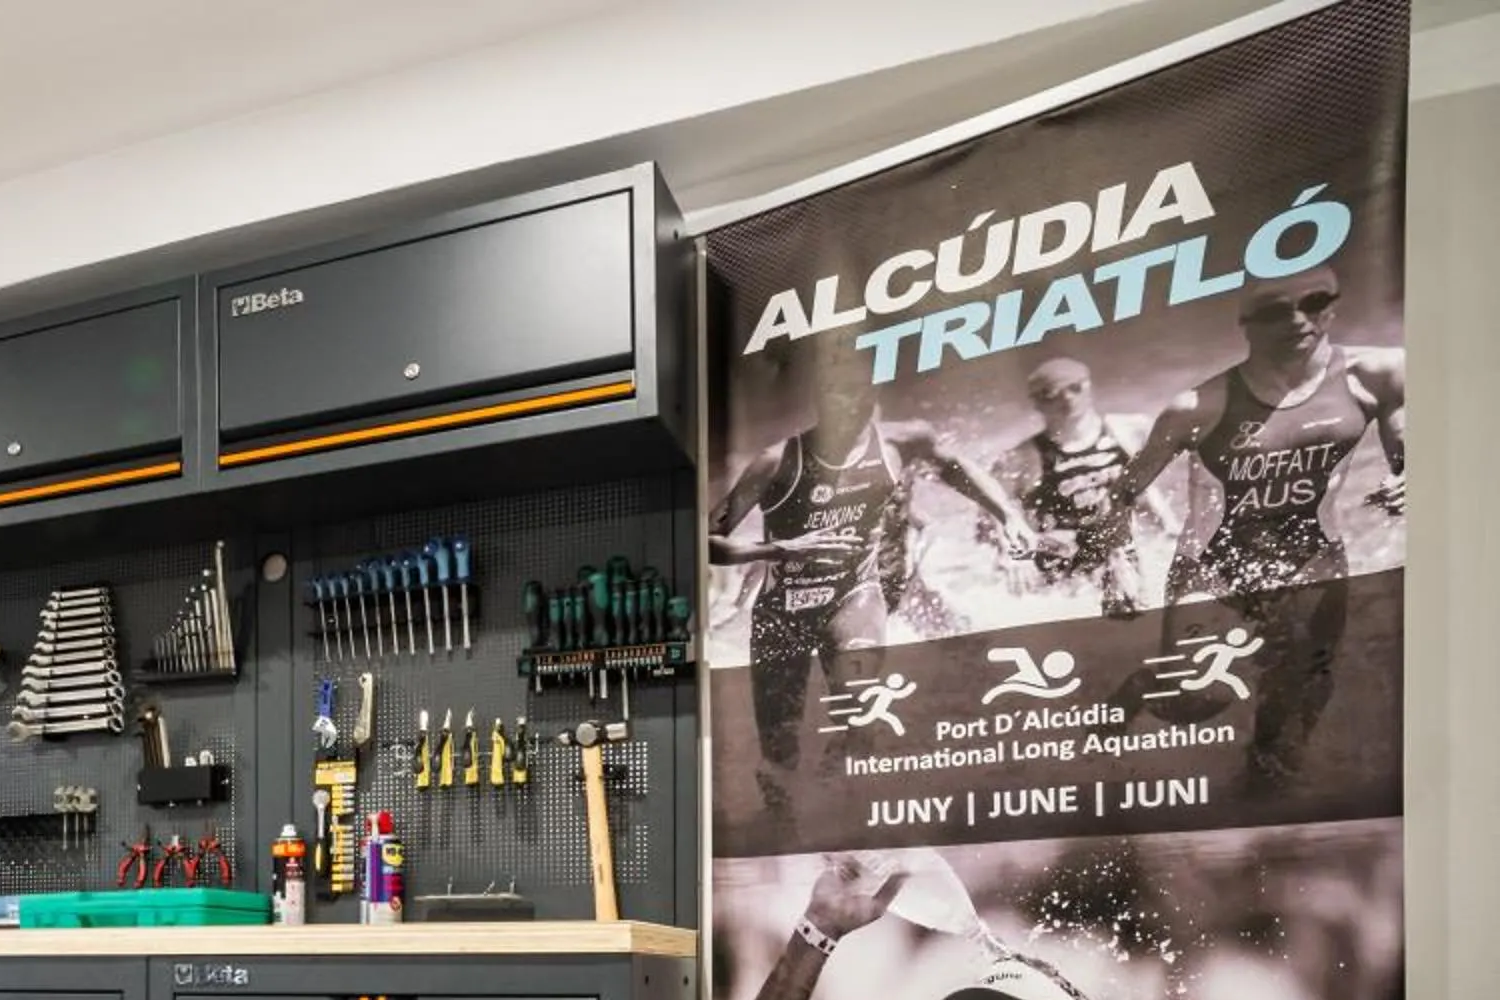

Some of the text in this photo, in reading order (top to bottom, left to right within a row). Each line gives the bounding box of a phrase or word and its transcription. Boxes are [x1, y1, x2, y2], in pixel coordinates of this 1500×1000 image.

[743, 161, 1216, 355] ALCÚDIA
[251, 287, 305, 313] Beta
[855, 183, 1352, 385] TRIATLÓ
[1228, 442, 1335, 480] MOFFATT
[803, 503, 867, 529] JENKINS
[1230, 479, 1316, 515] AUS
[936, 718, 988, 741] Port
[845, 724, 1236, 776] International Long Aquathlon
[867, 796, 953, 827] JUNY
[988, 786, 1078, 818] JUNE
[1120, 776, 1210, 809] JUNI
